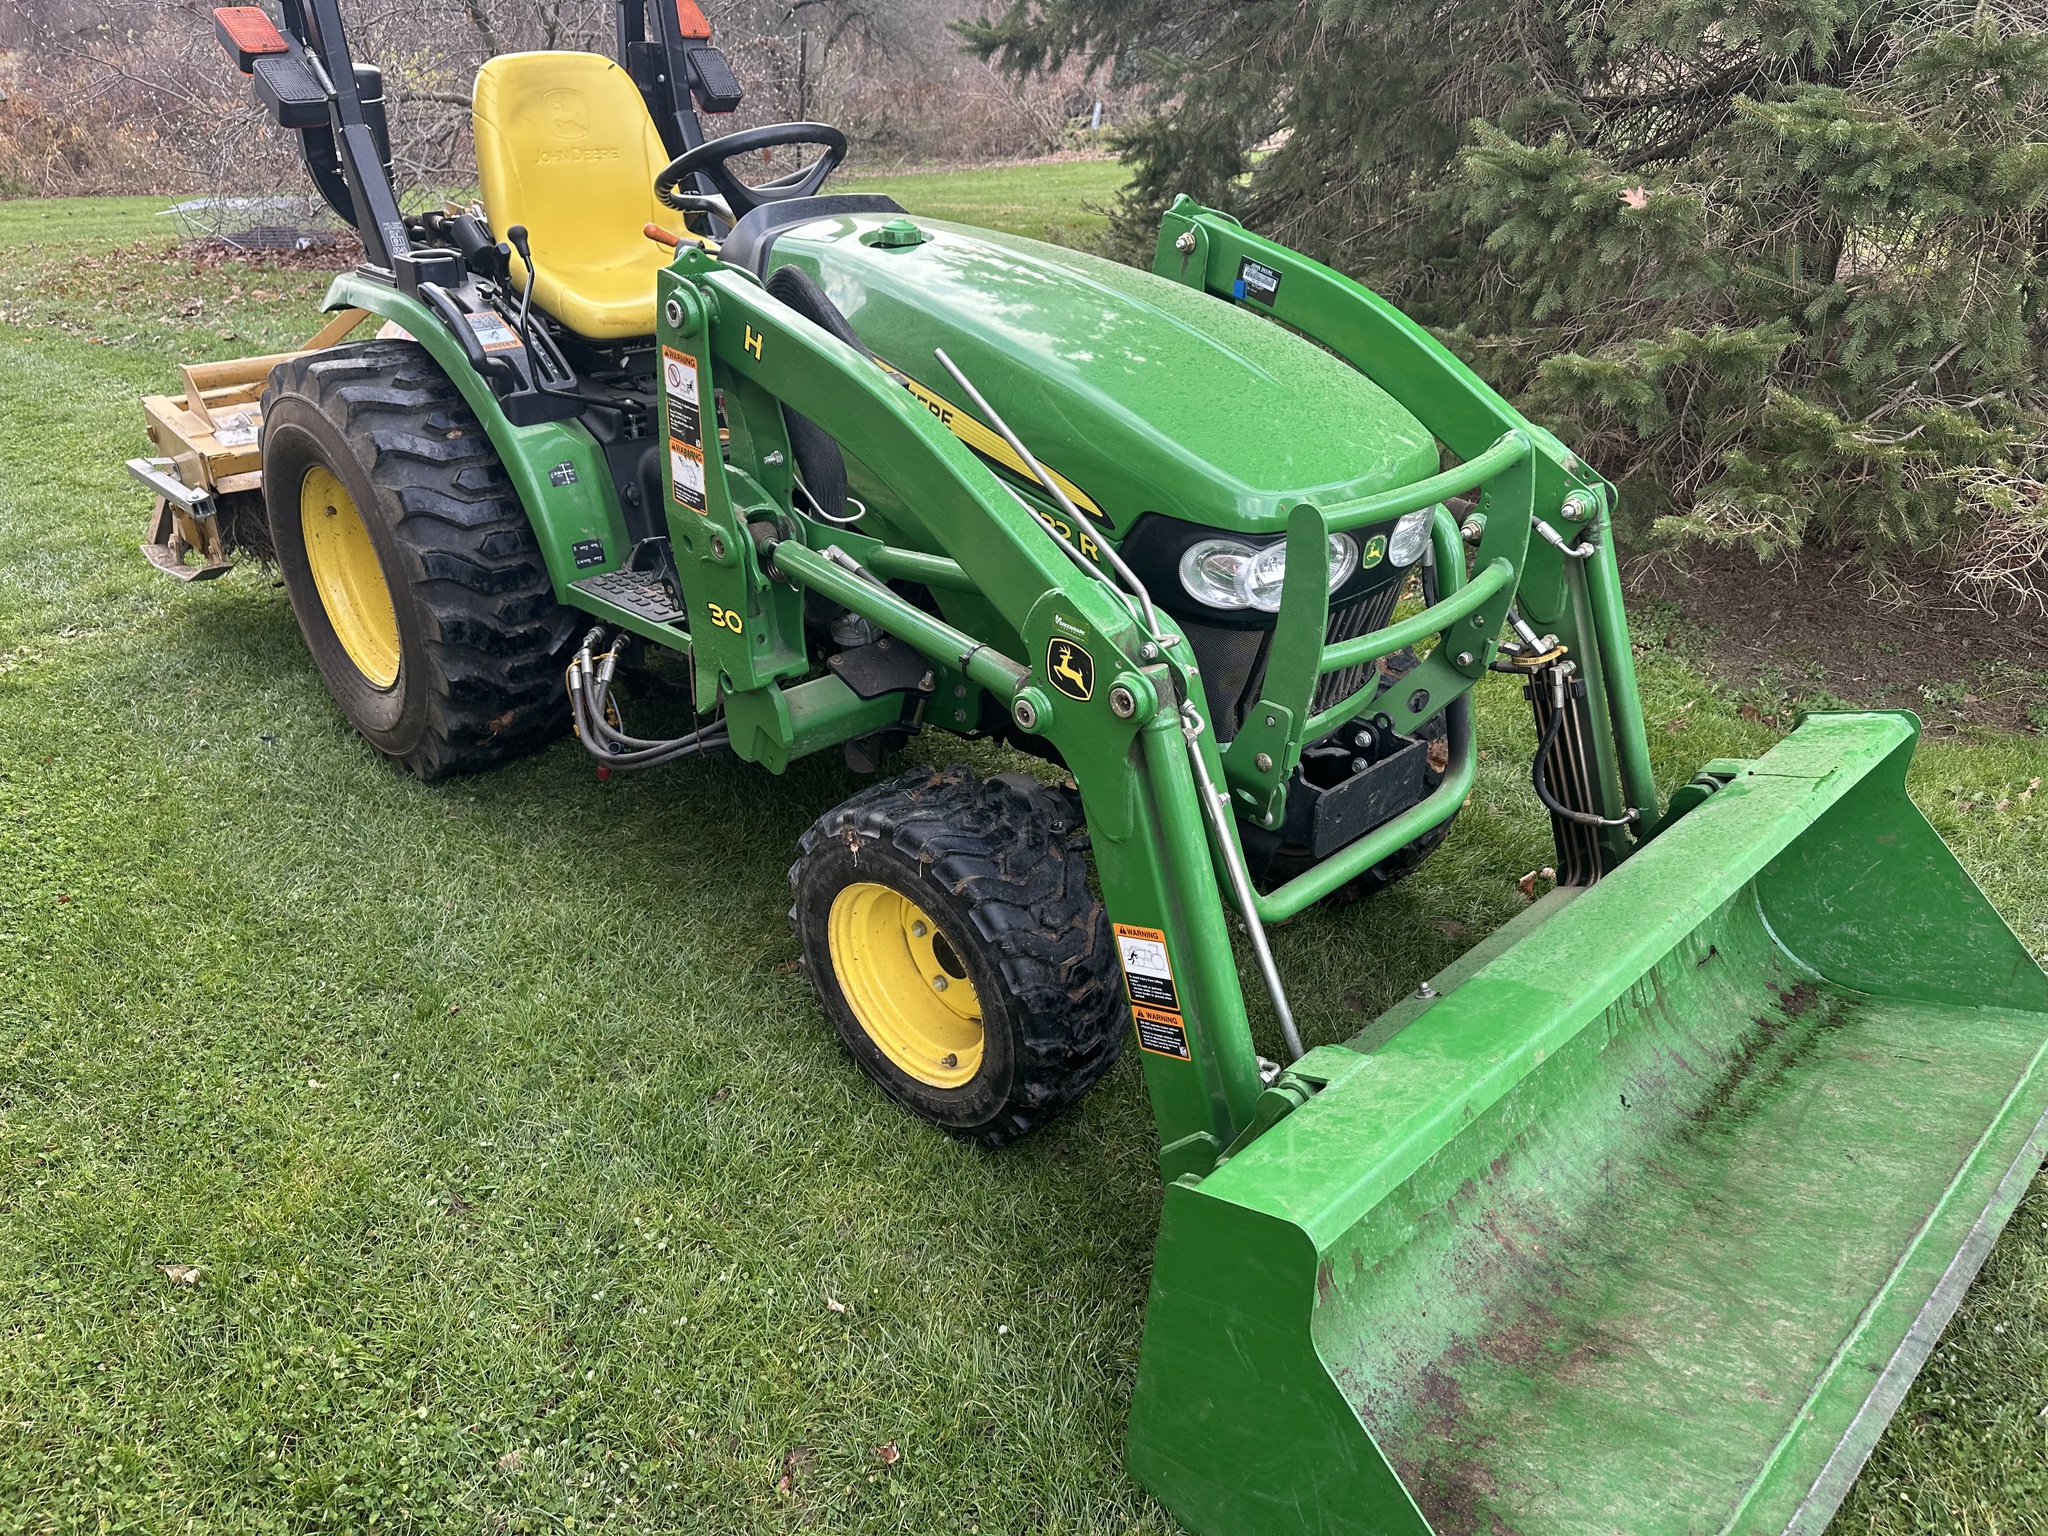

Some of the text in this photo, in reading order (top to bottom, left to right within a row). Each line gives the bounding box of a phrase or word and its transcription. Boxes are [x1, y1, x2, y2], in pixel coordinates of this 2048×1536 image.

[534, 147, 619, 164] JOHN DEERE
[744, 321, 763, 363] H
[668, 351, 696, 368] WARNING
[675, 444, 703, 462] WARNING
[707, 602, 744, 635] 30
[1126, 928, 1159, 940] WARNING
[1146, 1011, 1178, 1025] WARNING
